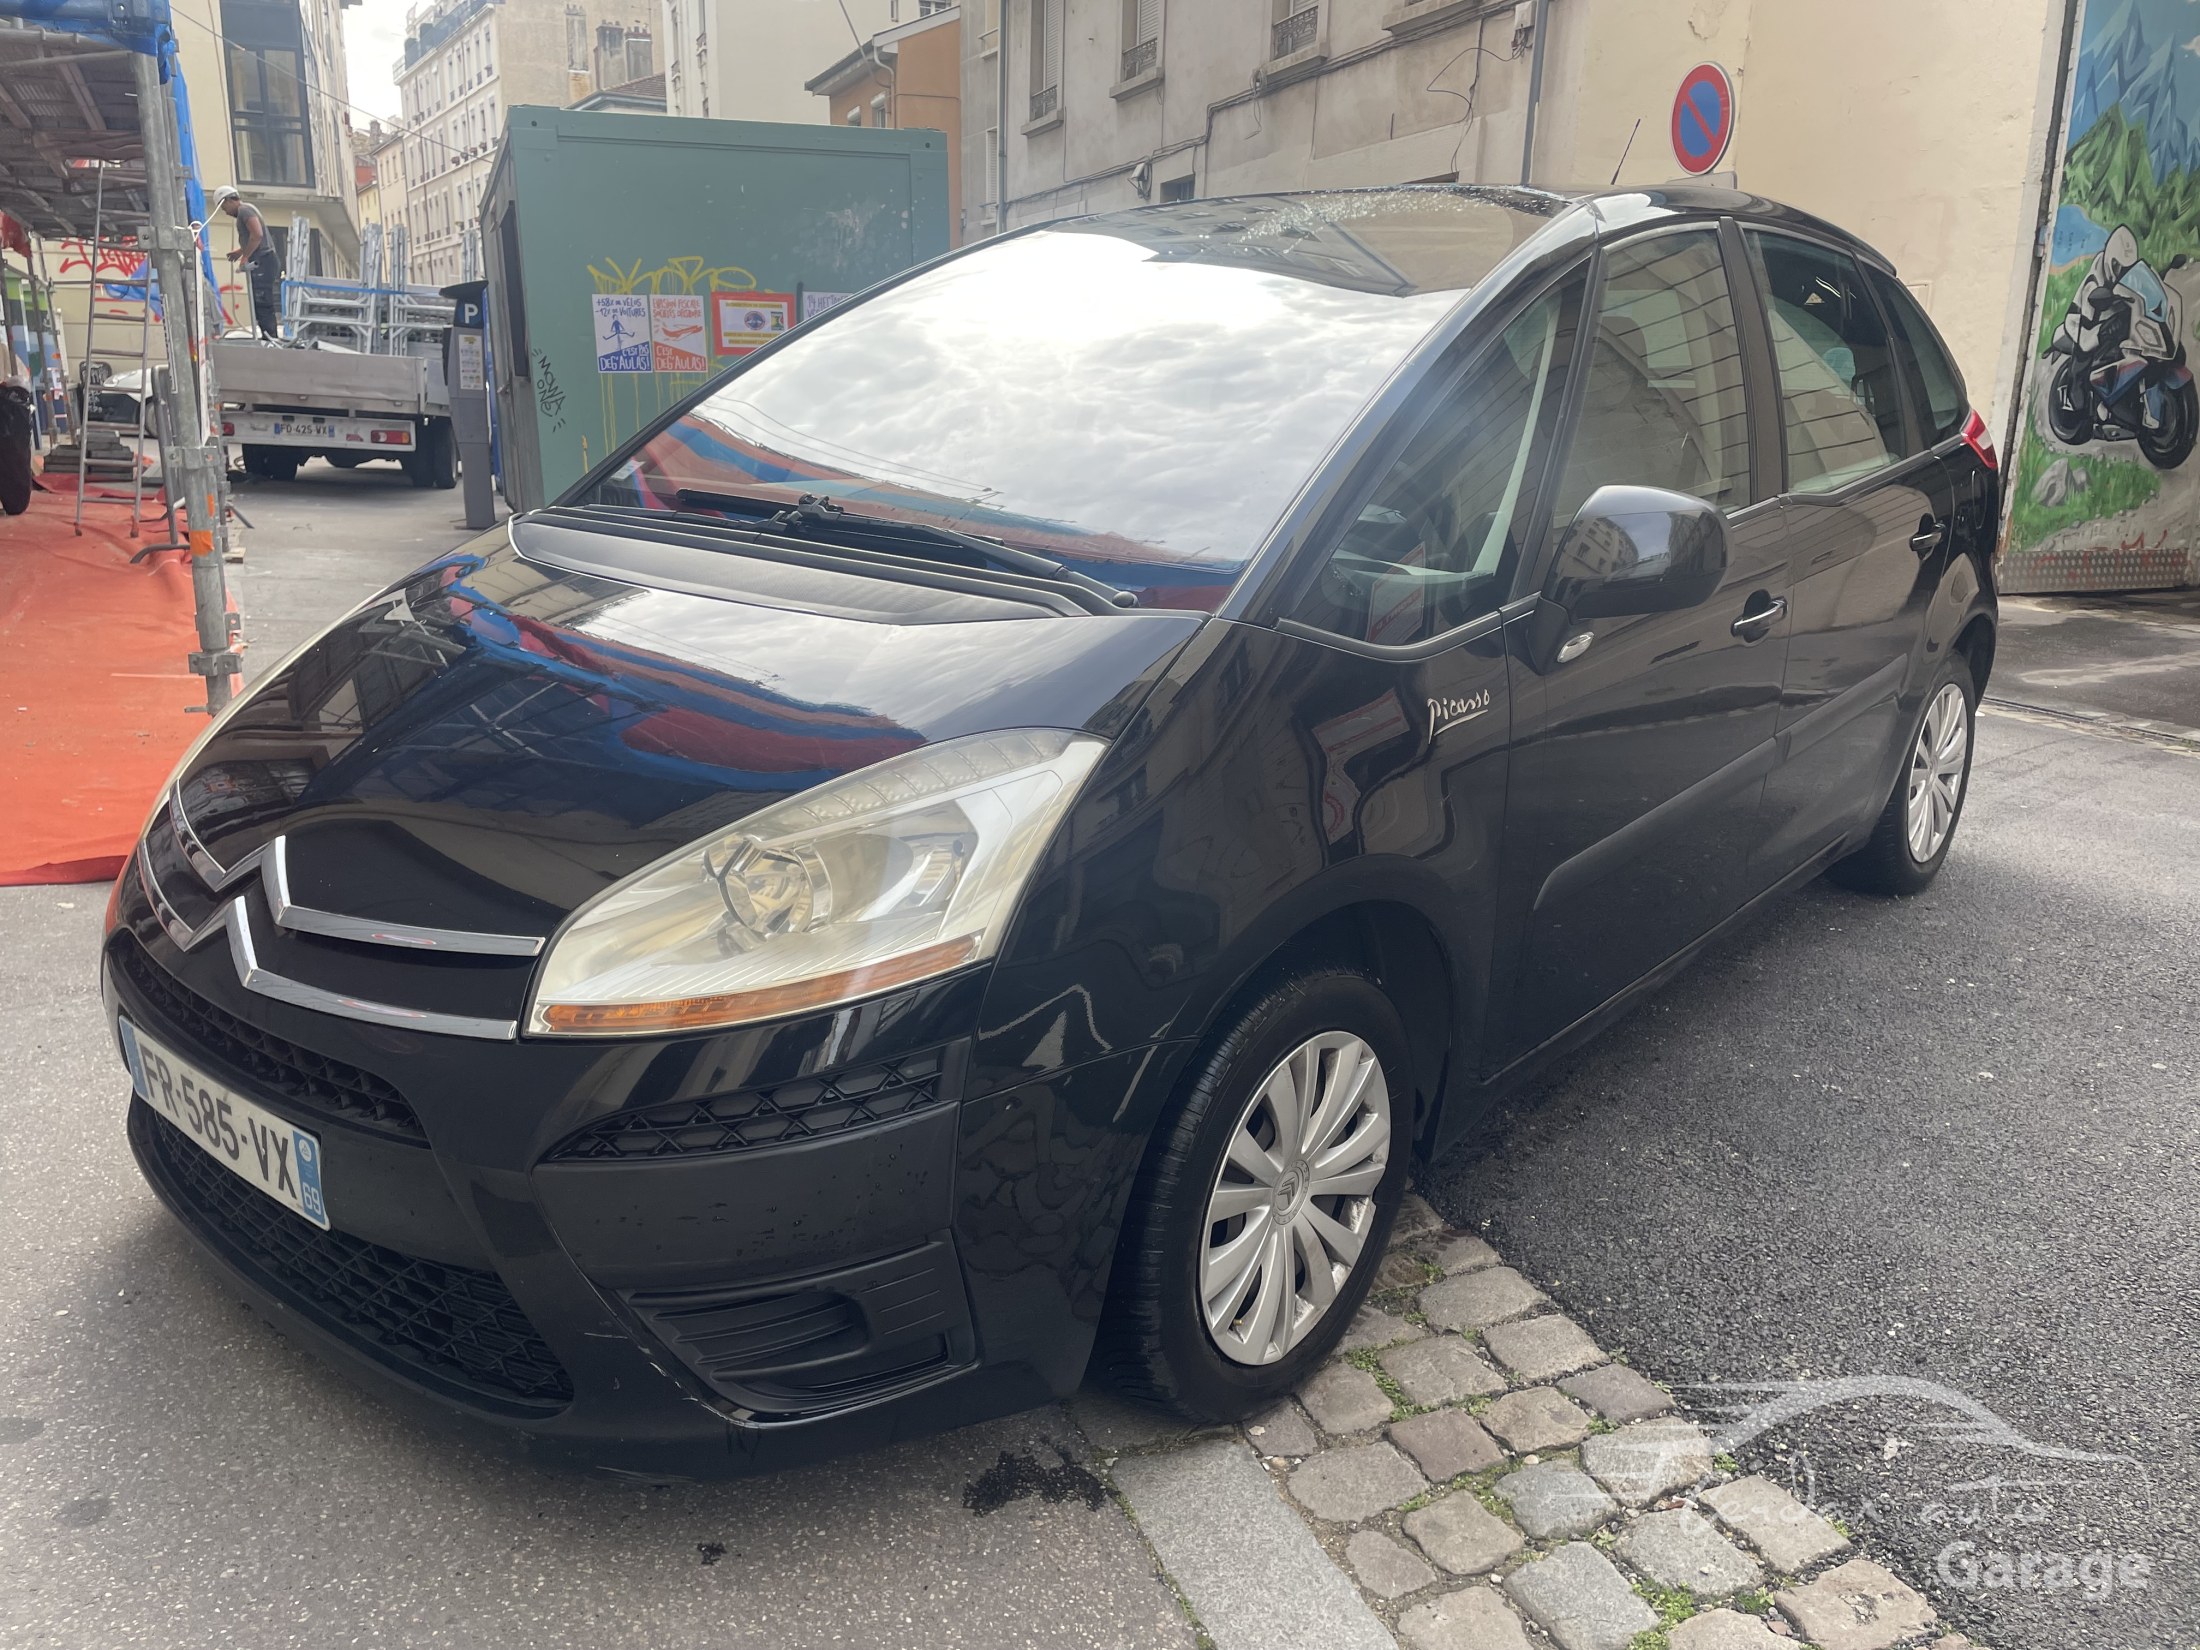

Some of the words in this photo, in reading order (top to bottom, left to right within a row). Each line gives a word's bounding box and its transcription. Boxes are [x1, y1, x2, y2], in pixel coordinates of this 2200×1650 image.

[464, 303, 479, 324] P
[1427, 689, 1490, 744] Picasso
[139, 1042, 298, 1200] FR-585-VX
[302, 1182, 322, 1216] 69
